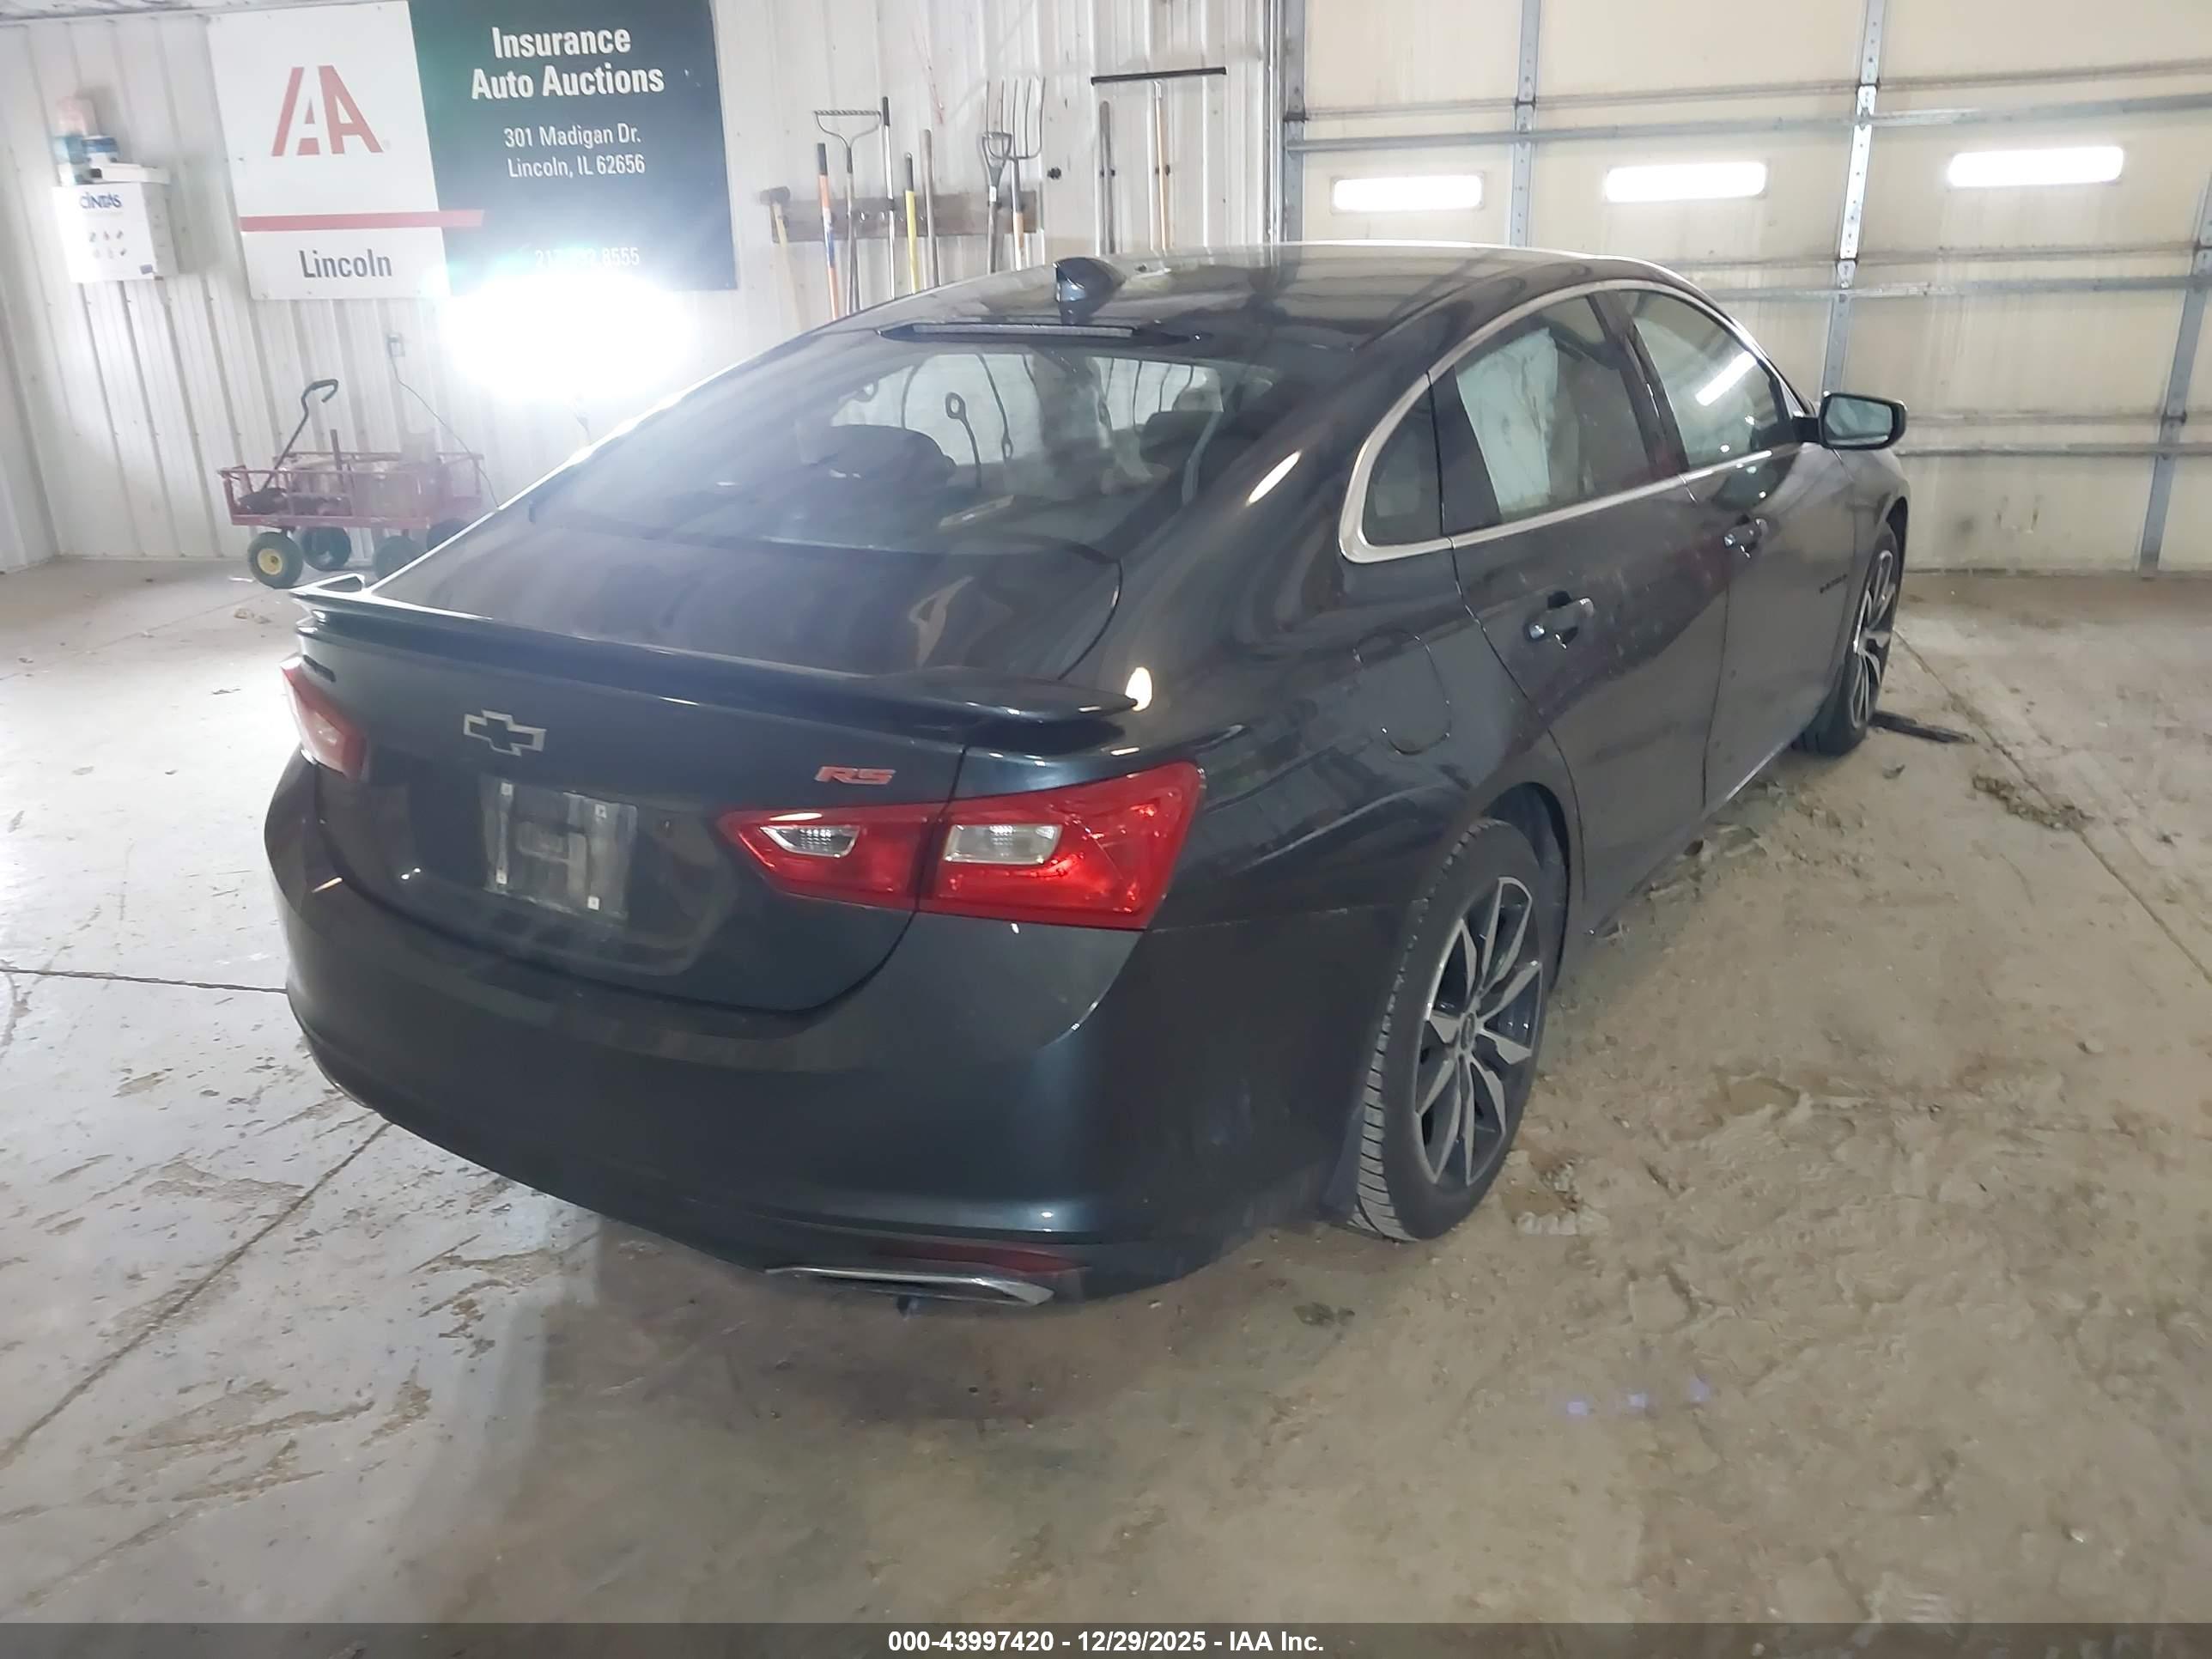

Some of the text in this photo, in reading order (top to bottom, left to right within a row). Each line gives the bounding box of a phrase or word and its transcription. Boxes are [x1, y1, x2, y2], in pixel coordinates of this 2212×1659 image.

[492, 27, 631, 58] Insurance
[471, 62, 665, 100] Auto Auctions
[504, 123, 641, 149] 301 Madigan Dr.
[507, 154, 645, 179] Lincoln, IL 62656
[299, 248, 392, 278] Lincoln
[814, 766, 896, 785] RS
